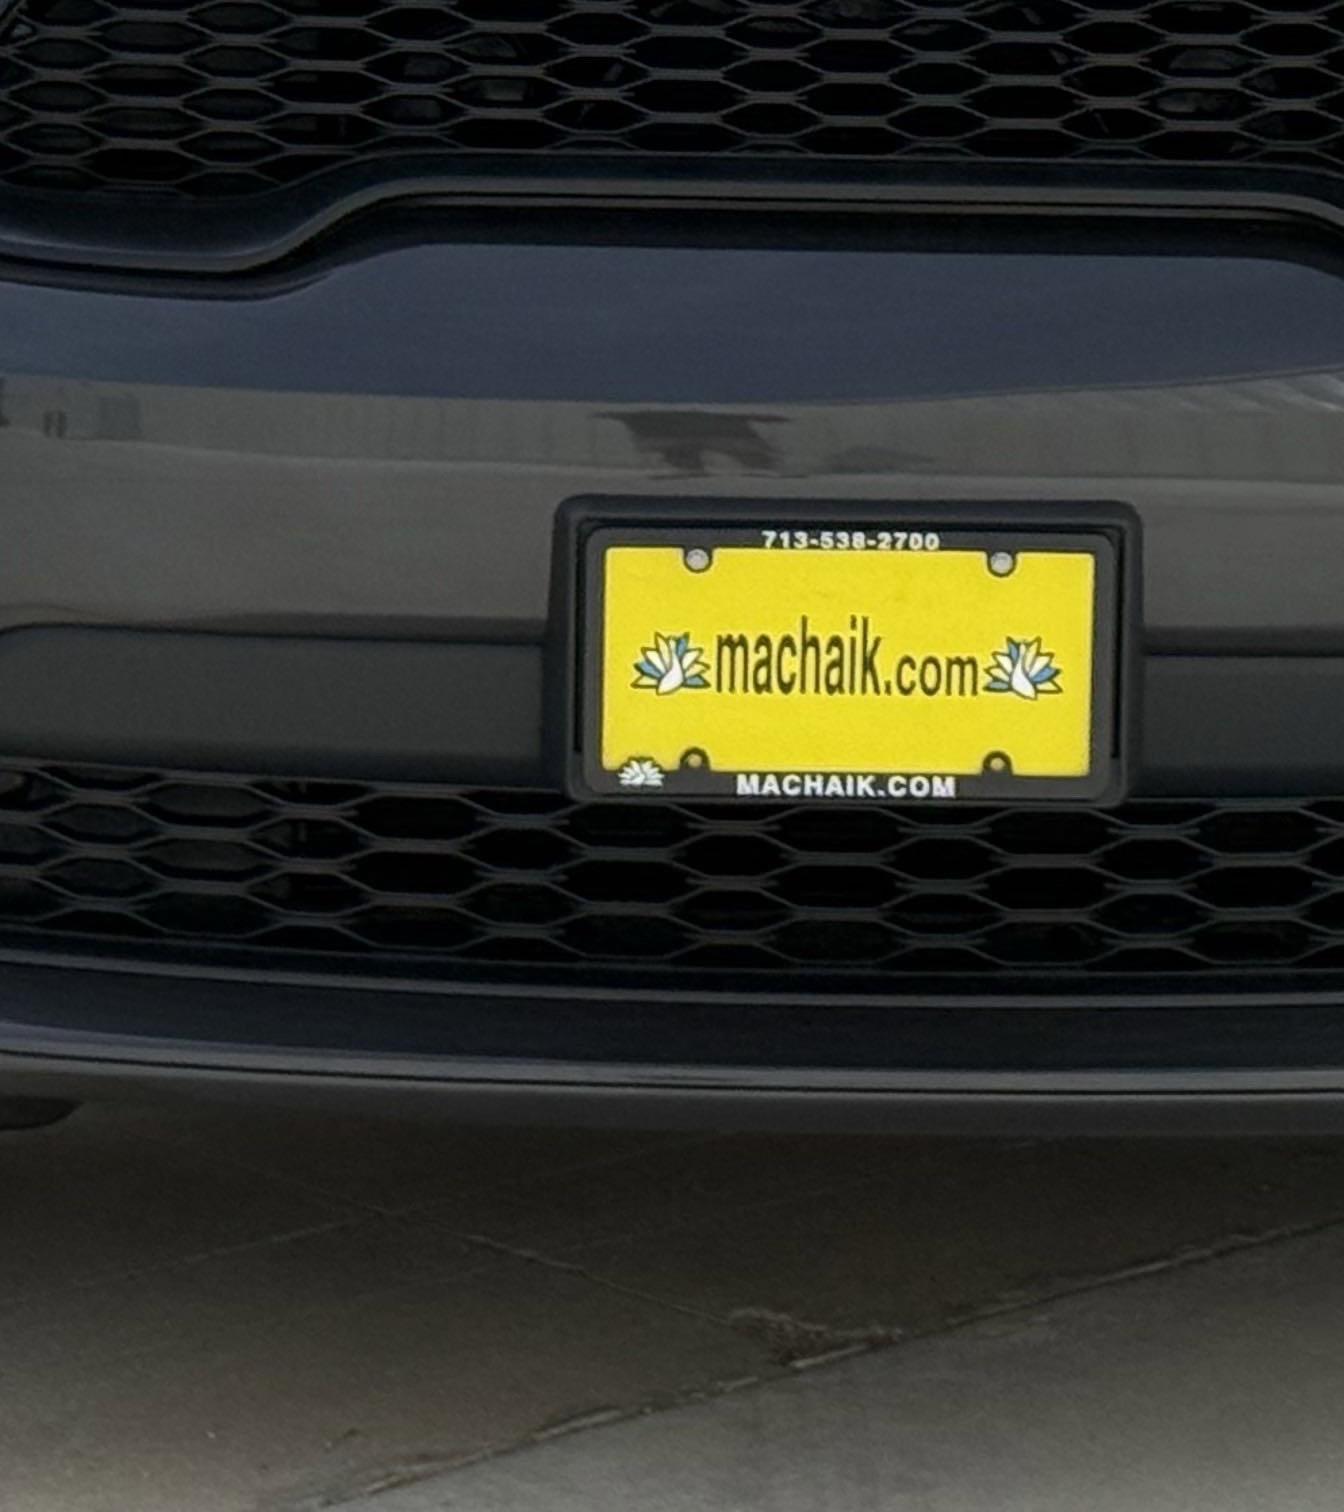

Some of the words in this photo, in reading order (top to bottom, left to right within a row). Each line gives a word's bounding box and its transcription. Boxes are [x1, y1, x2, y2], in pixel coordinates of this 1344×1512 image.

[763, 531, 940, 551] 713-538-2700
[716, 615, 979, 697] machaik.com
[737, 774, 956, 798] MACHAIK.COM
